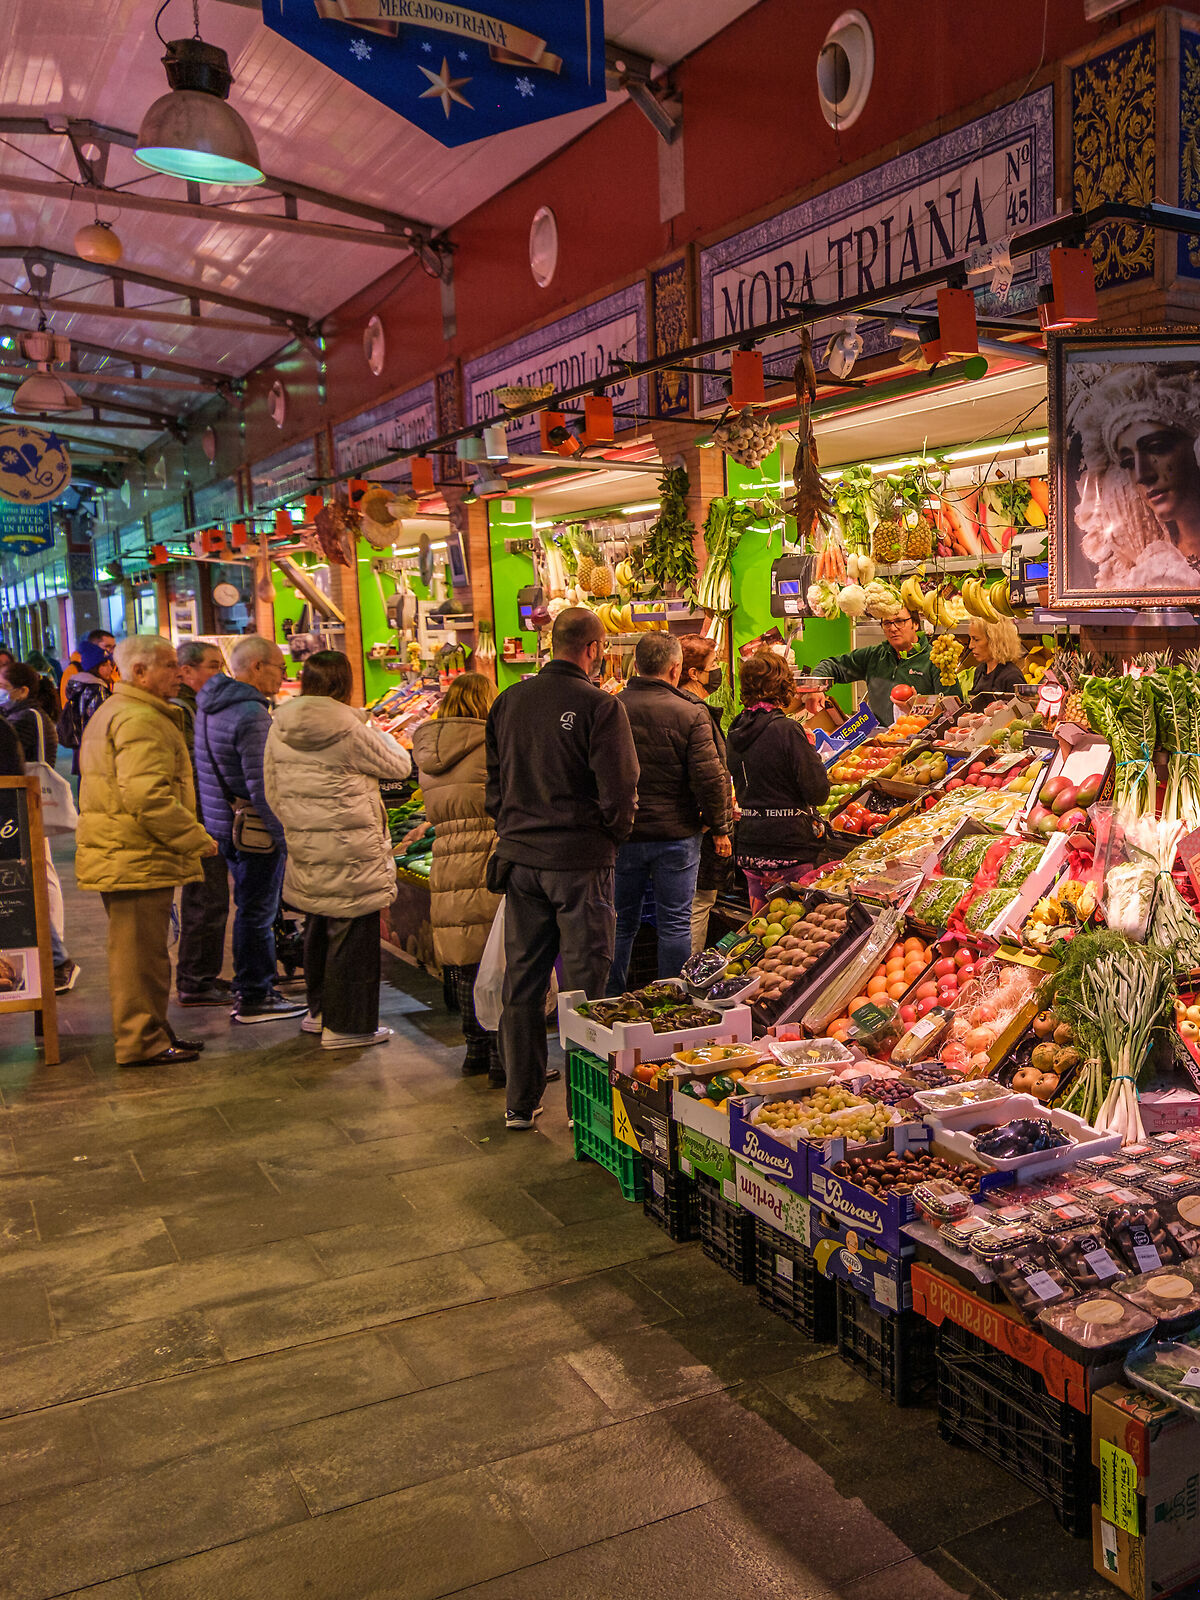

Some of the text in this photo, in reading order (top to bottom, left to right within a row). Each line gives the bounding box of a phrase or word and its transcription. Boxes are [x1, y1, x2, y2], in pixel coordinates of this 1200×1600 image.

[379, 0, 442, 21] MERCADO
[451, 11, 507, 47] TRIANA
[1006, 188, 1029, 227] 45
[721, 250, 818, 348] MORA
[827, 176, 988, 301] TRIANA
[766, 808, 793, 817] TENTH
[740, 1175, 783, 1221] Perlim
